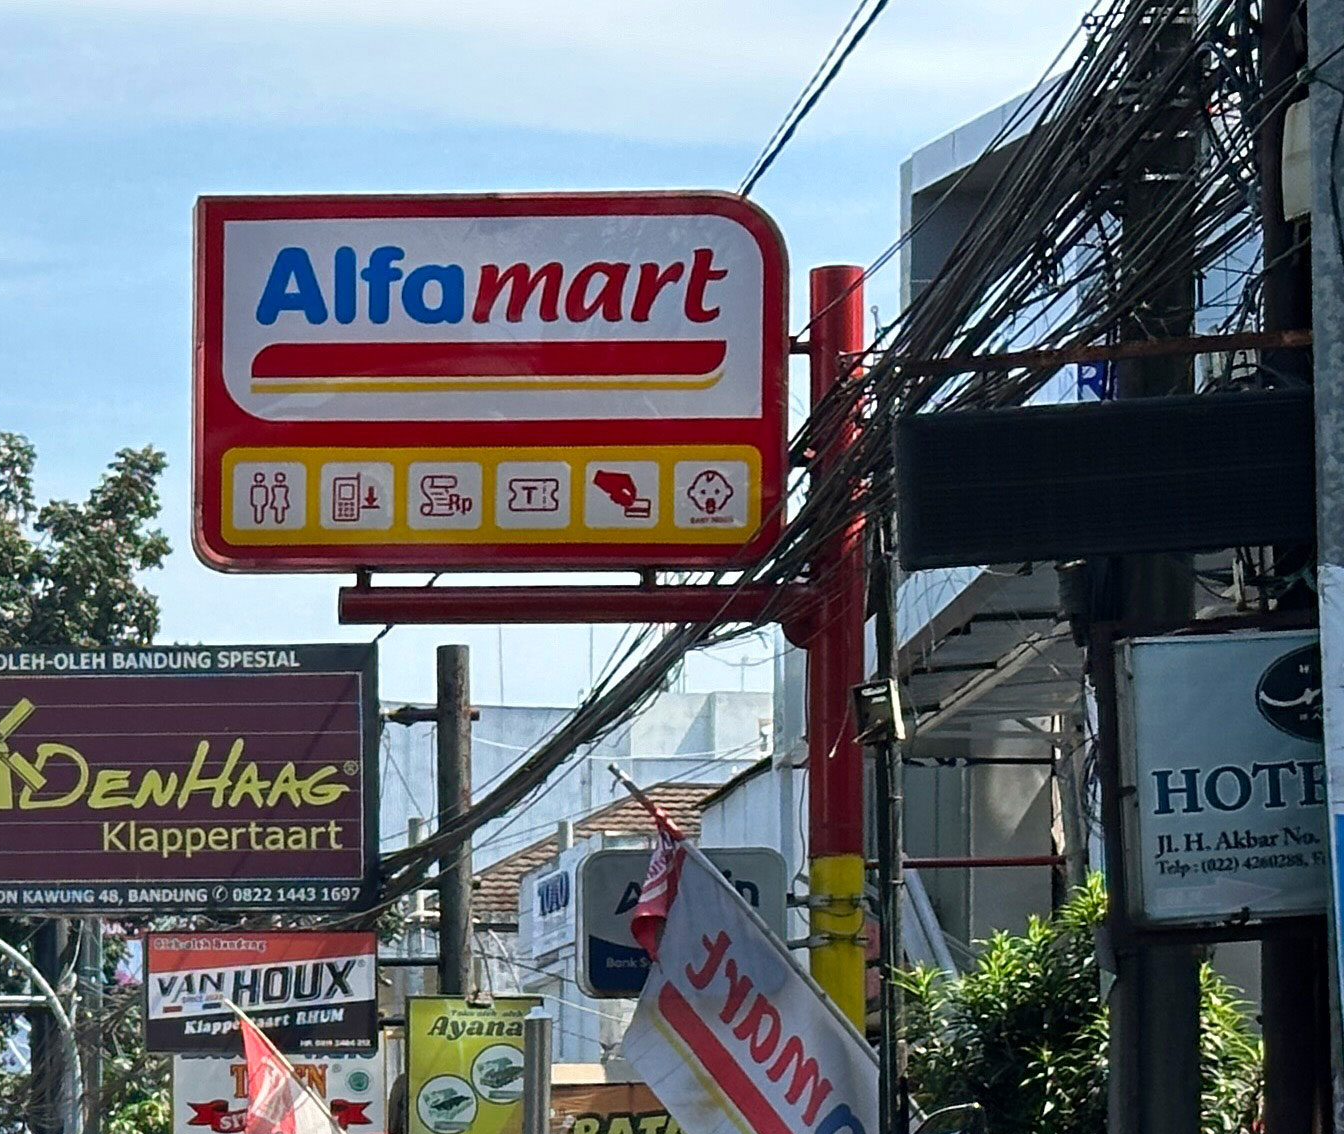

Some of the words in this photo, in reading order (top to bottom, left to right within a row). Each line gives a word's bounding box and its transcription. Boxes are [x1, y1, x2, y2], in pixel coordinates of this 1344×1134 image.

[255, 246, 729, 326] Alfamart
[112, 651, 212, 670] BANDUNG
[217, 649, 300, 668] SPESIAL
[102, 821, 343, 858] Klappertaart
[1216, 829, 1279, 850] Akbar
[1283, 827, 1320, 845] No.
[22, 890, 94, 904] KAWUNG
[98, 889, 124, 906] 48,
[128, 888, 208, 903] BANDUNG
[232, 887, 272, 903] 0822
[277, 887, 317, 902] 1443
[321, 886, 360, 902] 1697
[606, 957, 638, 969] Bank
[156, 971, 226, 1003] VAN
[231, 959, 357, 1007] HOUX
[295, 1007, 345, 1026] RHUM
[427, 1016, 524, 1041] Ayana
